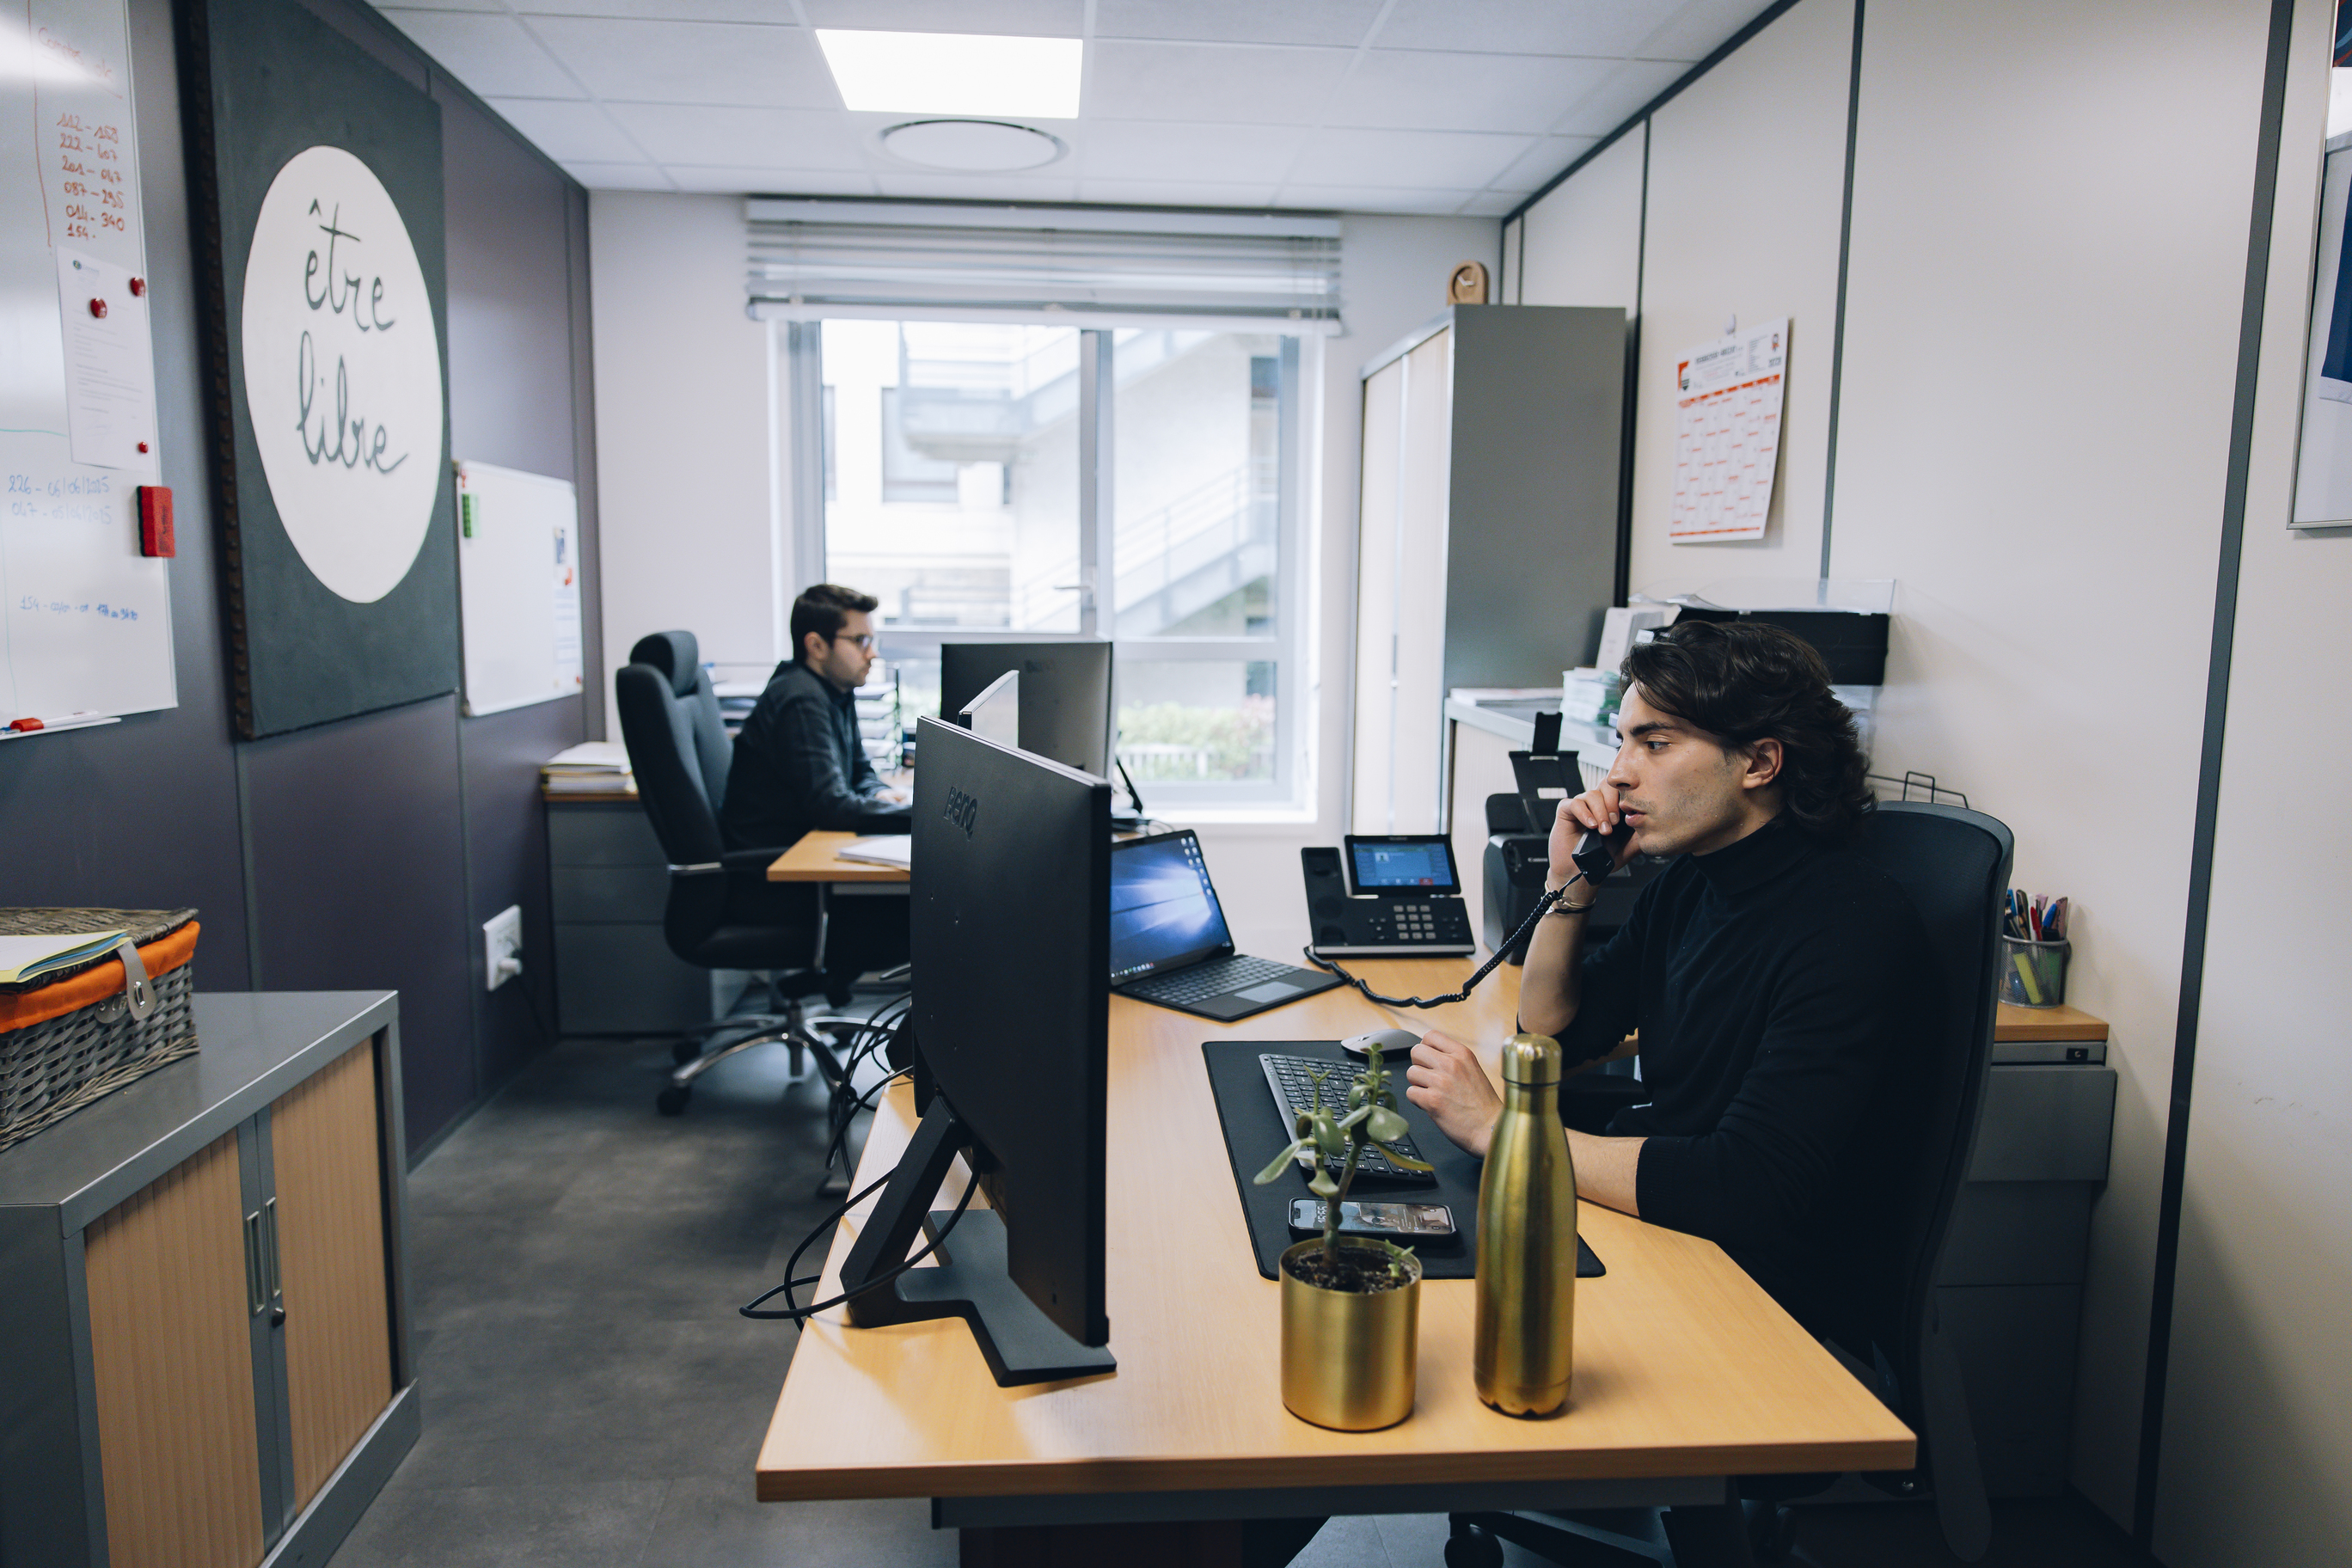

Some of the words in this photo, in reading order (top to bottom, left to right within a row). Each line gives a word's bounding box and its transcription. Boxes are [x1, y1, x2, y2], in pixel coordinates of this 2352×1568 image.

[57, 112, 83, 132] 112
[60, 132, 83, 152] 222
[62, 155, 85, 176] 201
[64, 181, 88, 197] 087
[101, 188, 124, 209] 295
[67, 223, 89, 241] 154
[305, 199, 395, 332] être
[296, 330, 409, 475] libre
[8, 475, 32, 495] 226
